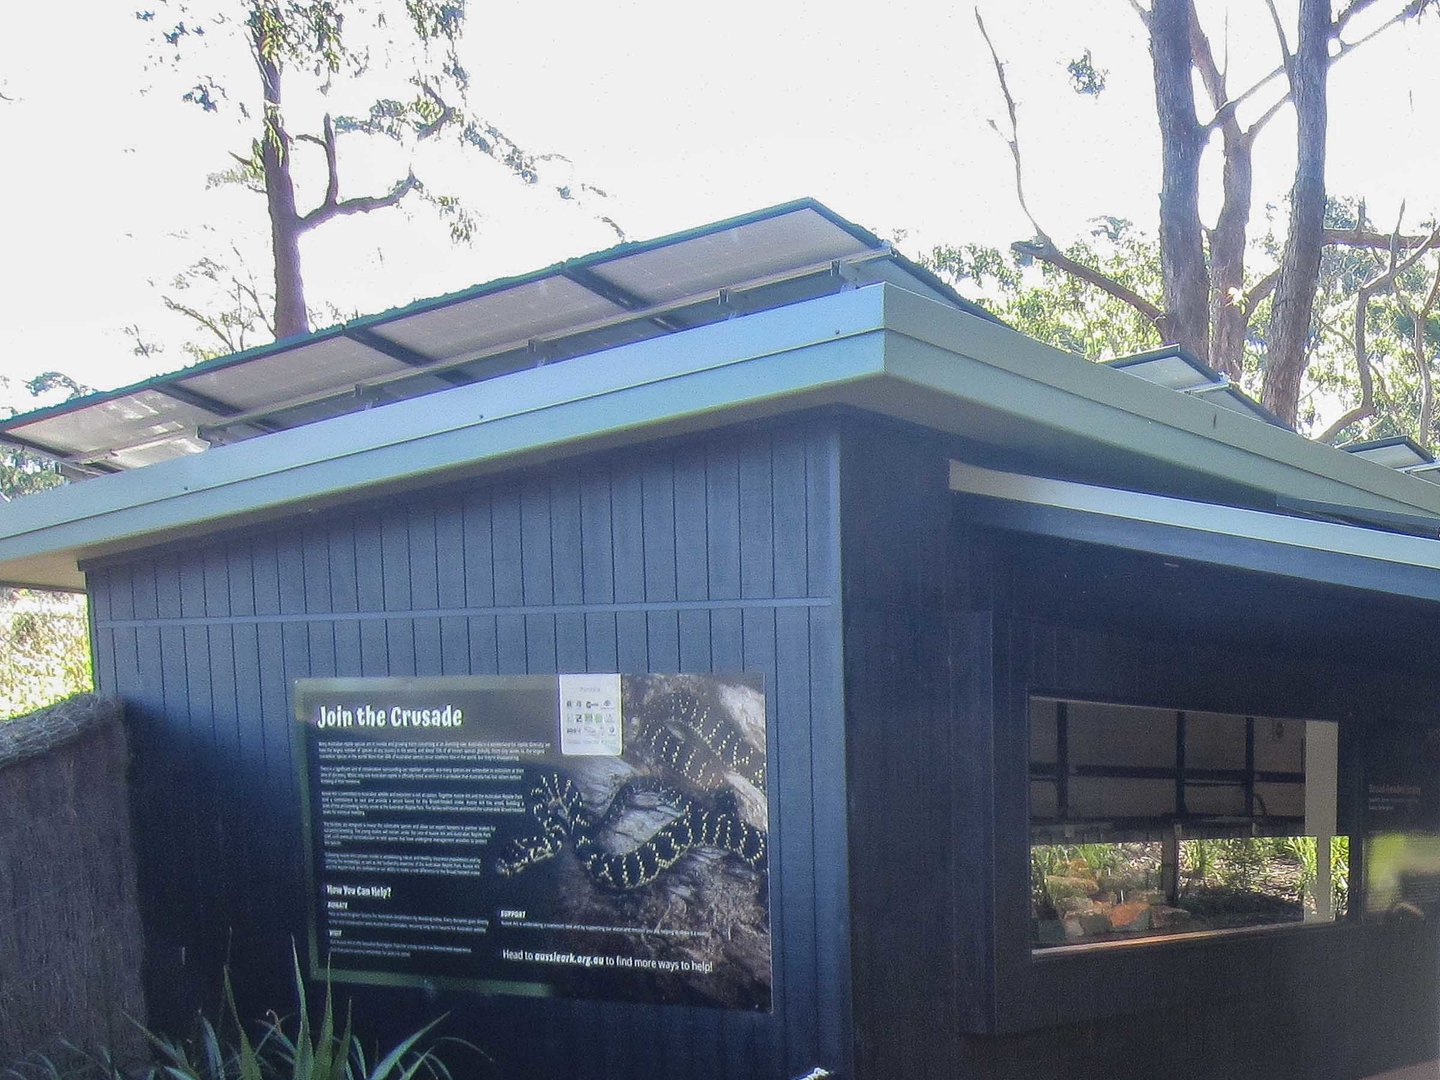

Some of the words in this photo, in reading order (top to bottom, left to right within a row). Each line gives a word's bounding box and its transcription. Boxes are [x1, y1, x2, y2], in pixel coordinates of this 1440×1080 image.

[317, 706, 352, 728] Join
[356, 706, 386, 727] the
[391, 705, 463, 727] Crusade
[326, 885, 342, 895] How
[343, 885, 355, 895] You
[357, 886, 370, 896] Can
[371, 886, 391, 899] Help?
[500, 909, 526, 919] SUPPORT
[502, 949, 523, 960] Head
[525, 951, 533, 960] to
[606, 956, 615, 966] to
[616, 955, 632, 966] find
[634, 959, 656, 969] more
[658, 960, 679, 972] ways
[681, 961, 690, 970] to
[691, 960, 713, 974] help!
